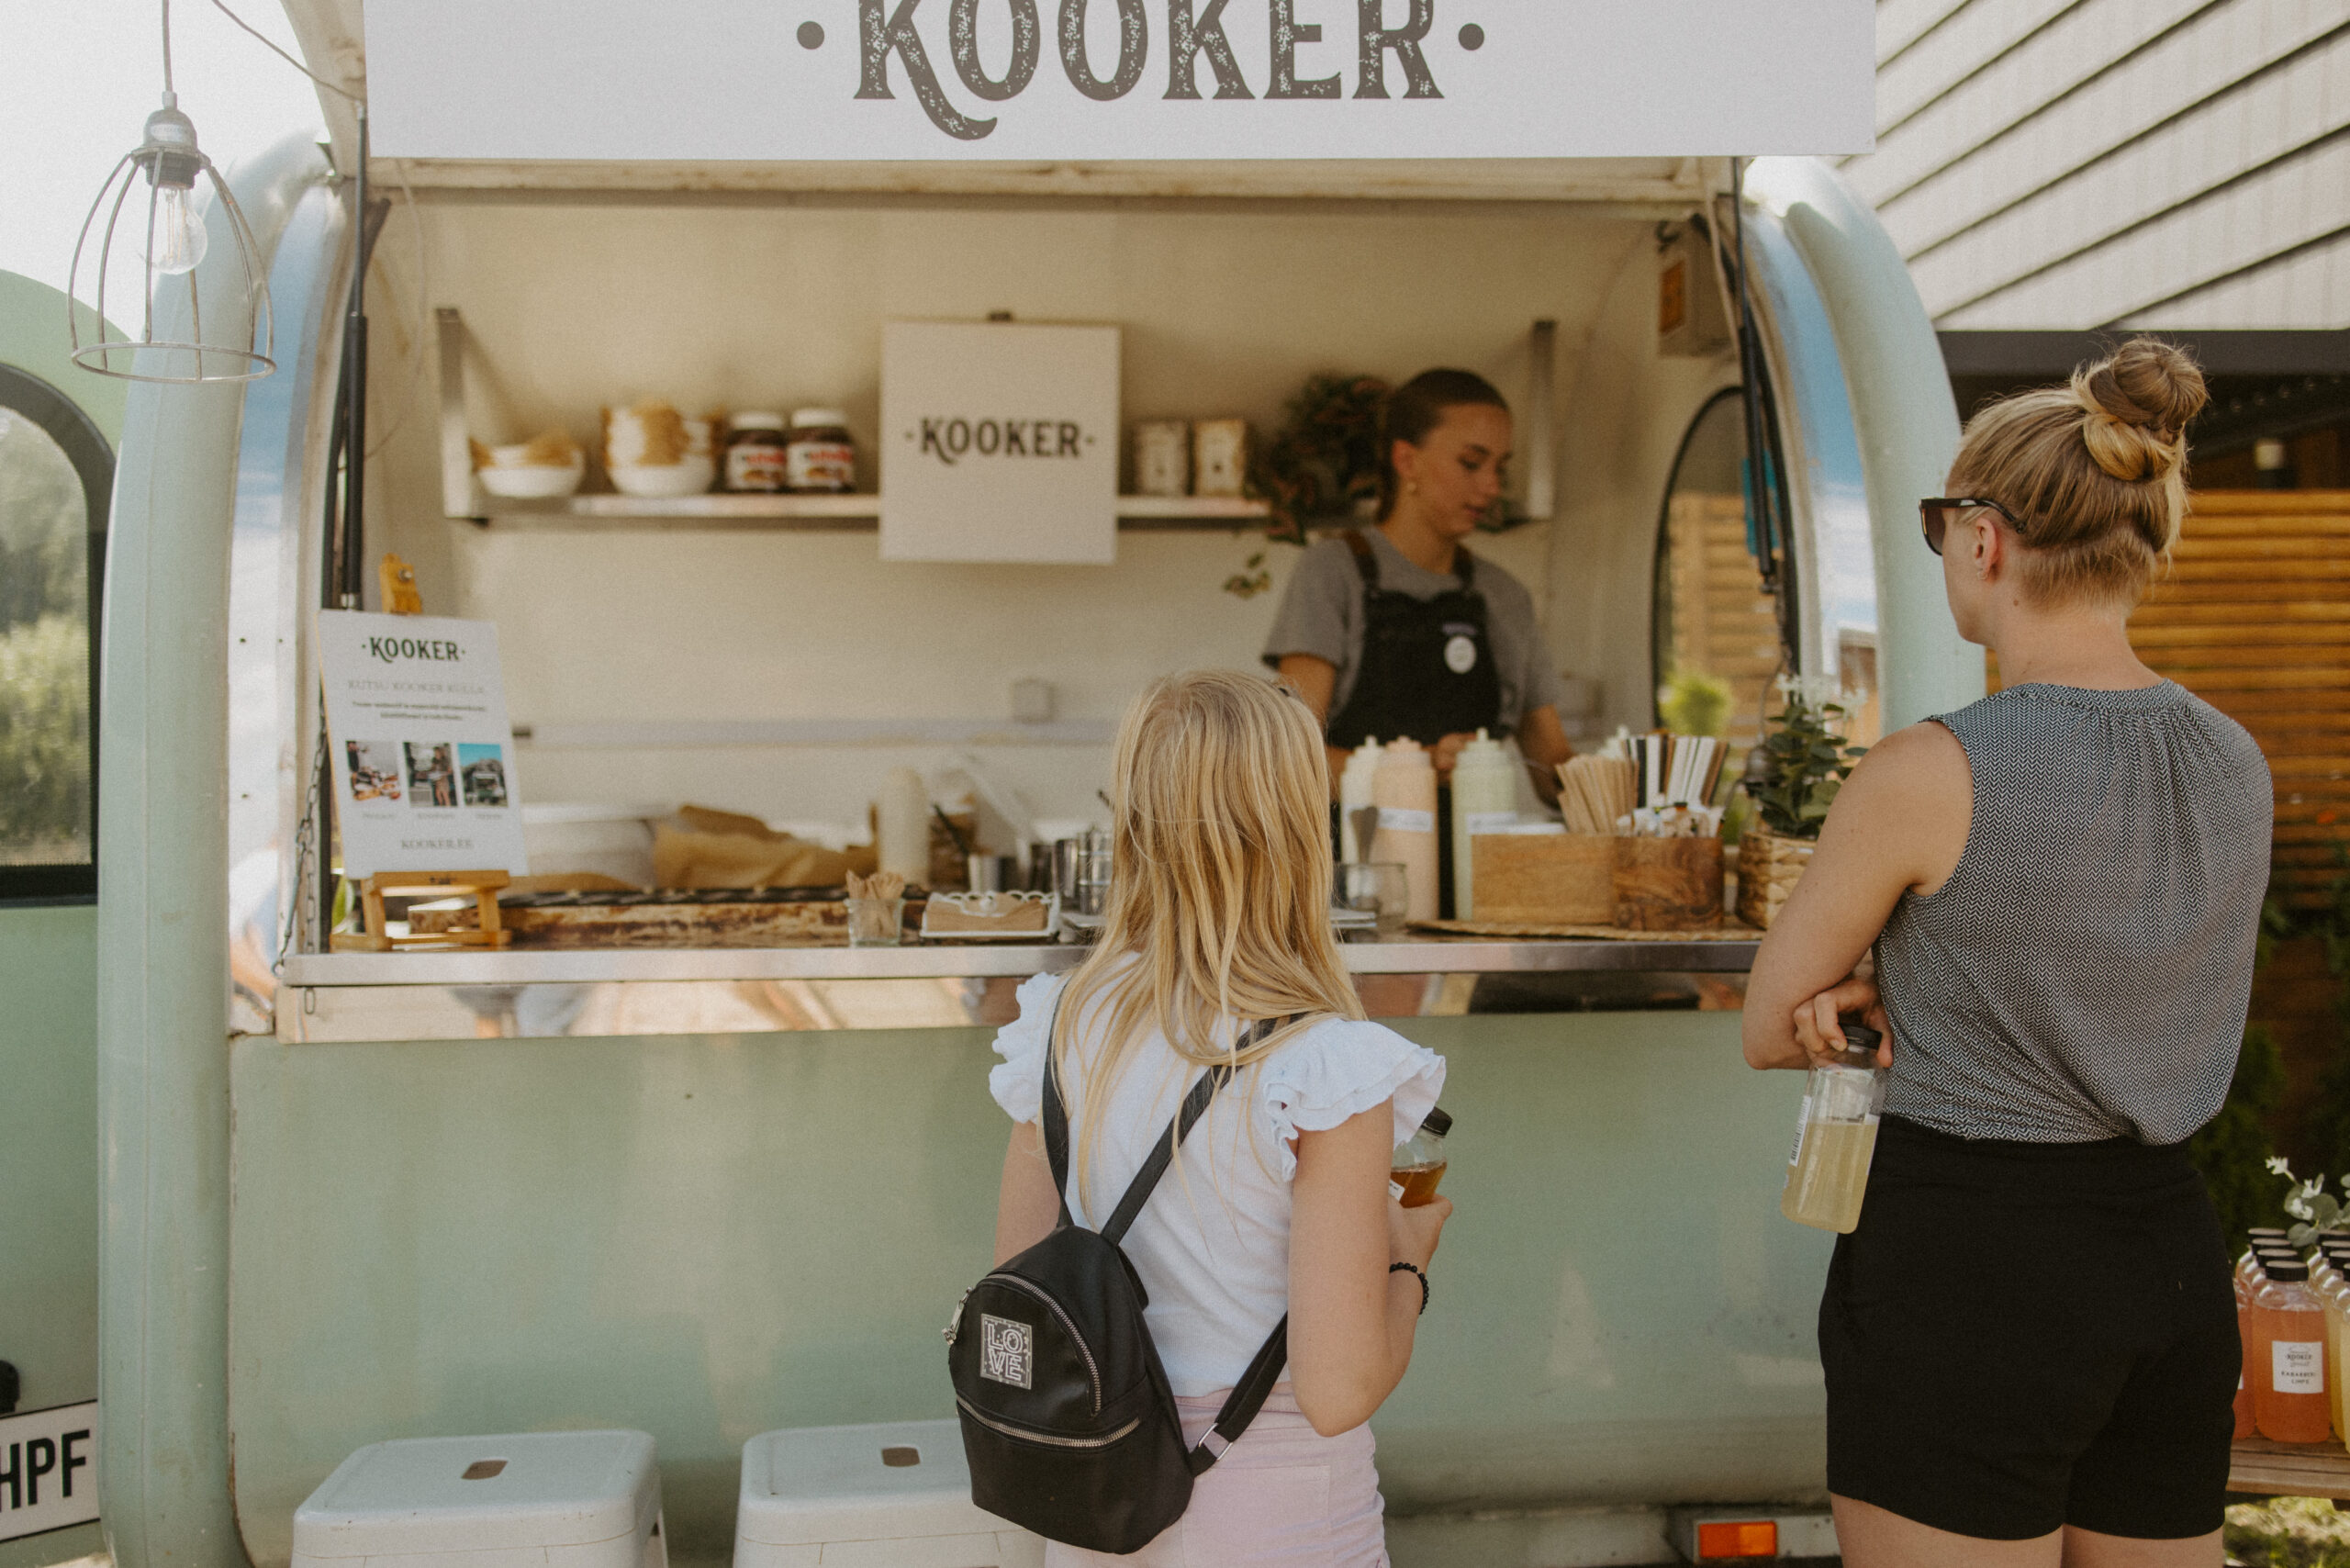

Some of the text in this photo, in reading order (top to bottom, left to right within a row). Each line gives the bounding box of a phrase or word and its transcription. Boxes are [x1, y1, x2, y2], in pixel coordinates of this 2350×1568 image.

[854, 0, 1445, 140] KOOKER
[921, 418, 1080, 465] KOOKER
[370, 637, 460, 664] KOOKER
